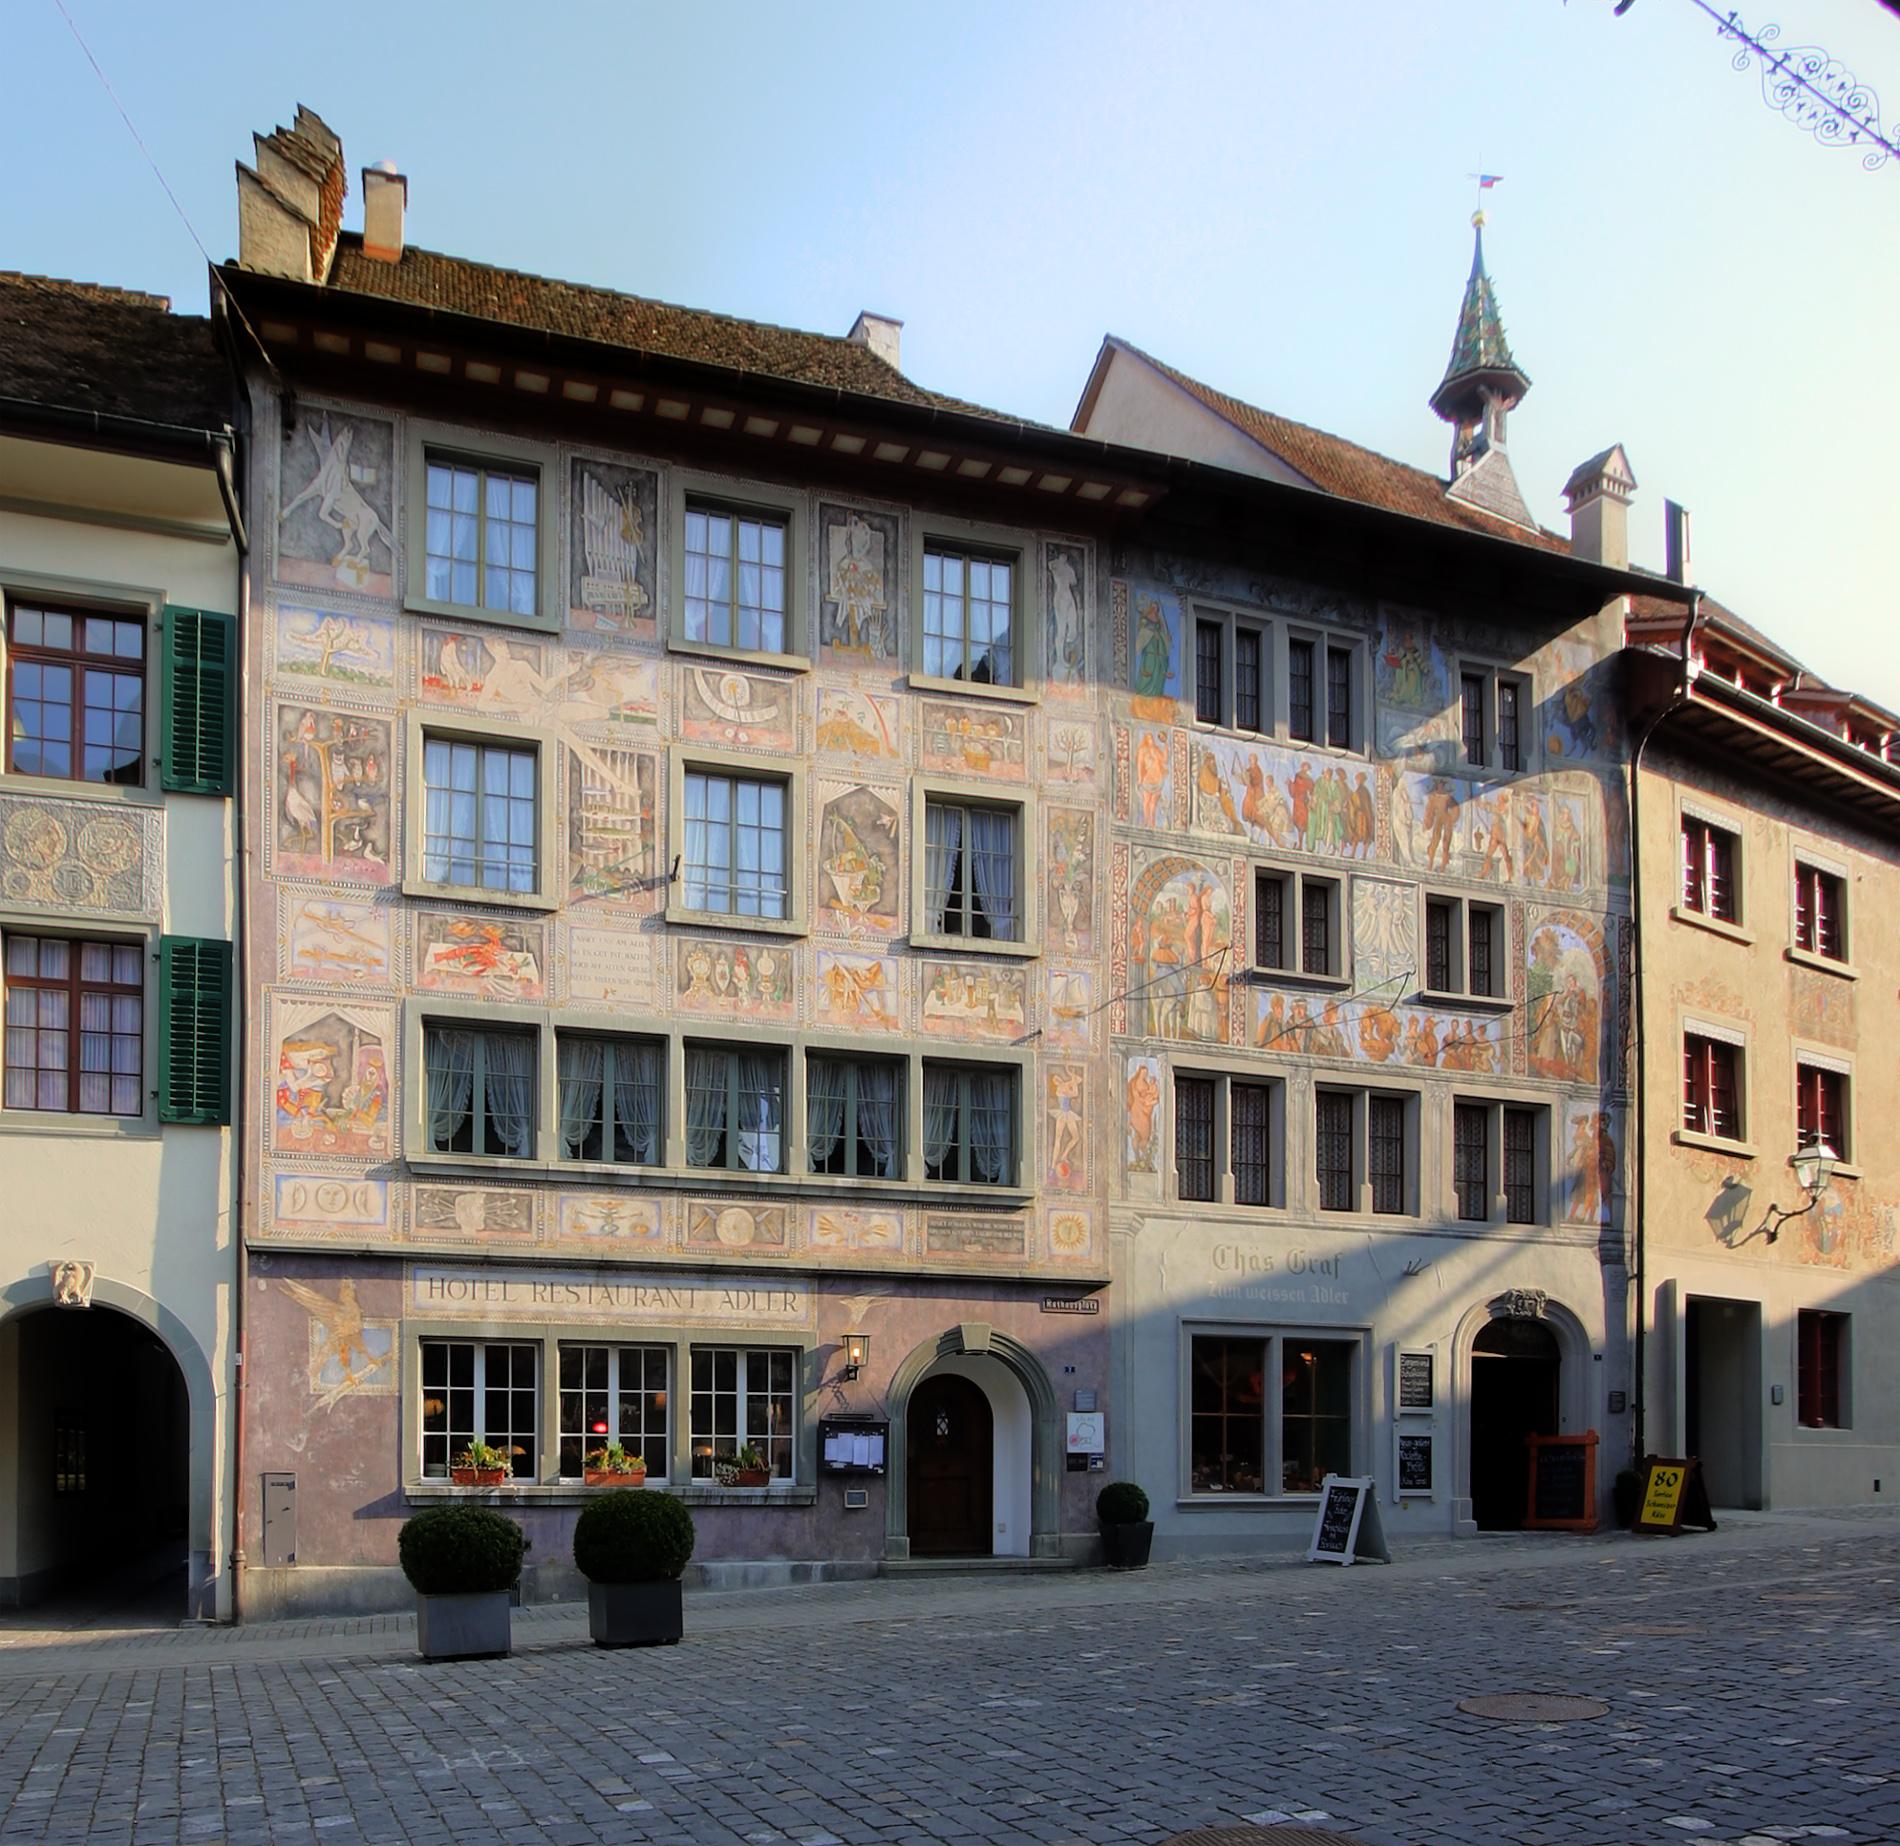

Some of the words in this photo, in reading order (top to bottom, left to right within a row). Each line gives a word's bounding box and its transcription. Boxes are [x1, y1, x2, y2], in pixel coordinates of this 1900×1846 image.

[1212, 1243, 1274, 1277] Chäs
[1286, 1248, 1344, 1280] Graf
[429, 1277, 517, 1302] HOTEL
[532, 1281, 697, 1309] RESTAURANT
[719, 1289, 799, 1312] ADLER
[1246, 1286, 1306, 1304] weissen
[1310, 1285, 1350, 1304] Adler
[1654, 1471, 1678, 1487] 80
